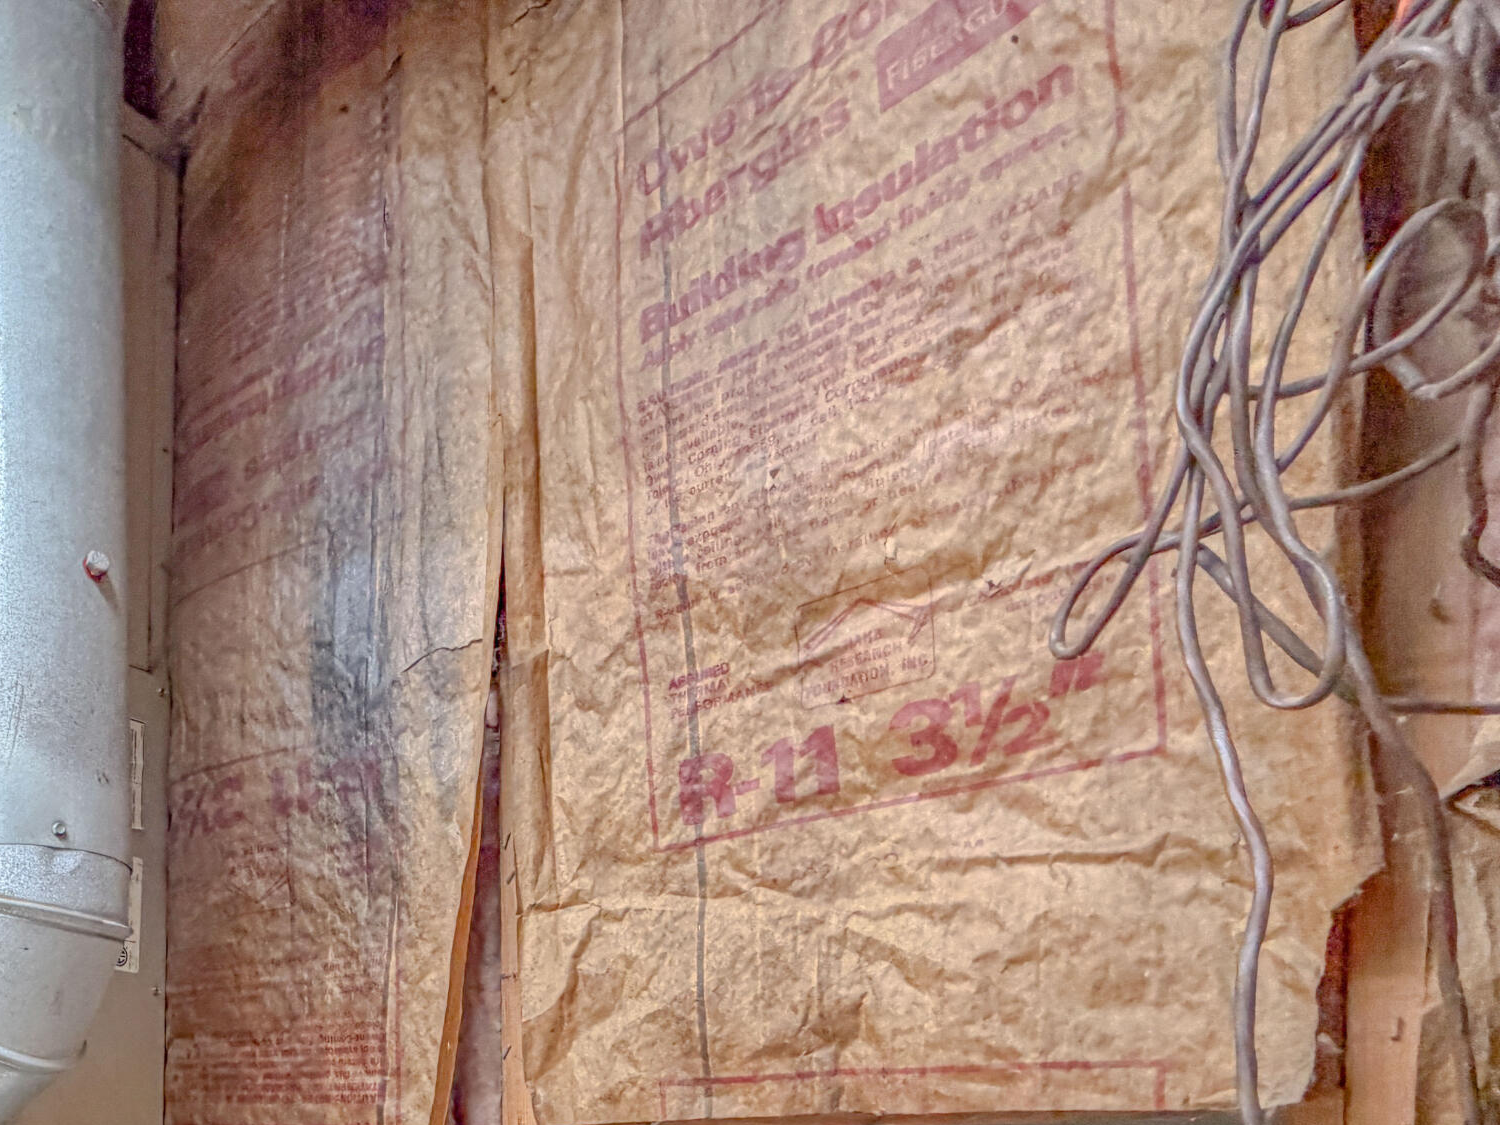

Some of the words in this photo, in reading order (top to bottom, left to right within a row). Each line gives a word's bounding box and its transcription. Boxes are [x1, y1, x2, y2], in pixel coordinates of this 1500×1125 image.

[637, 0, 891, 197] Owens-Co
[639, 228, 806, 345] Building
[813, 63, 1076, 246] Insulation
[678, 725, 841, 826] R-11
